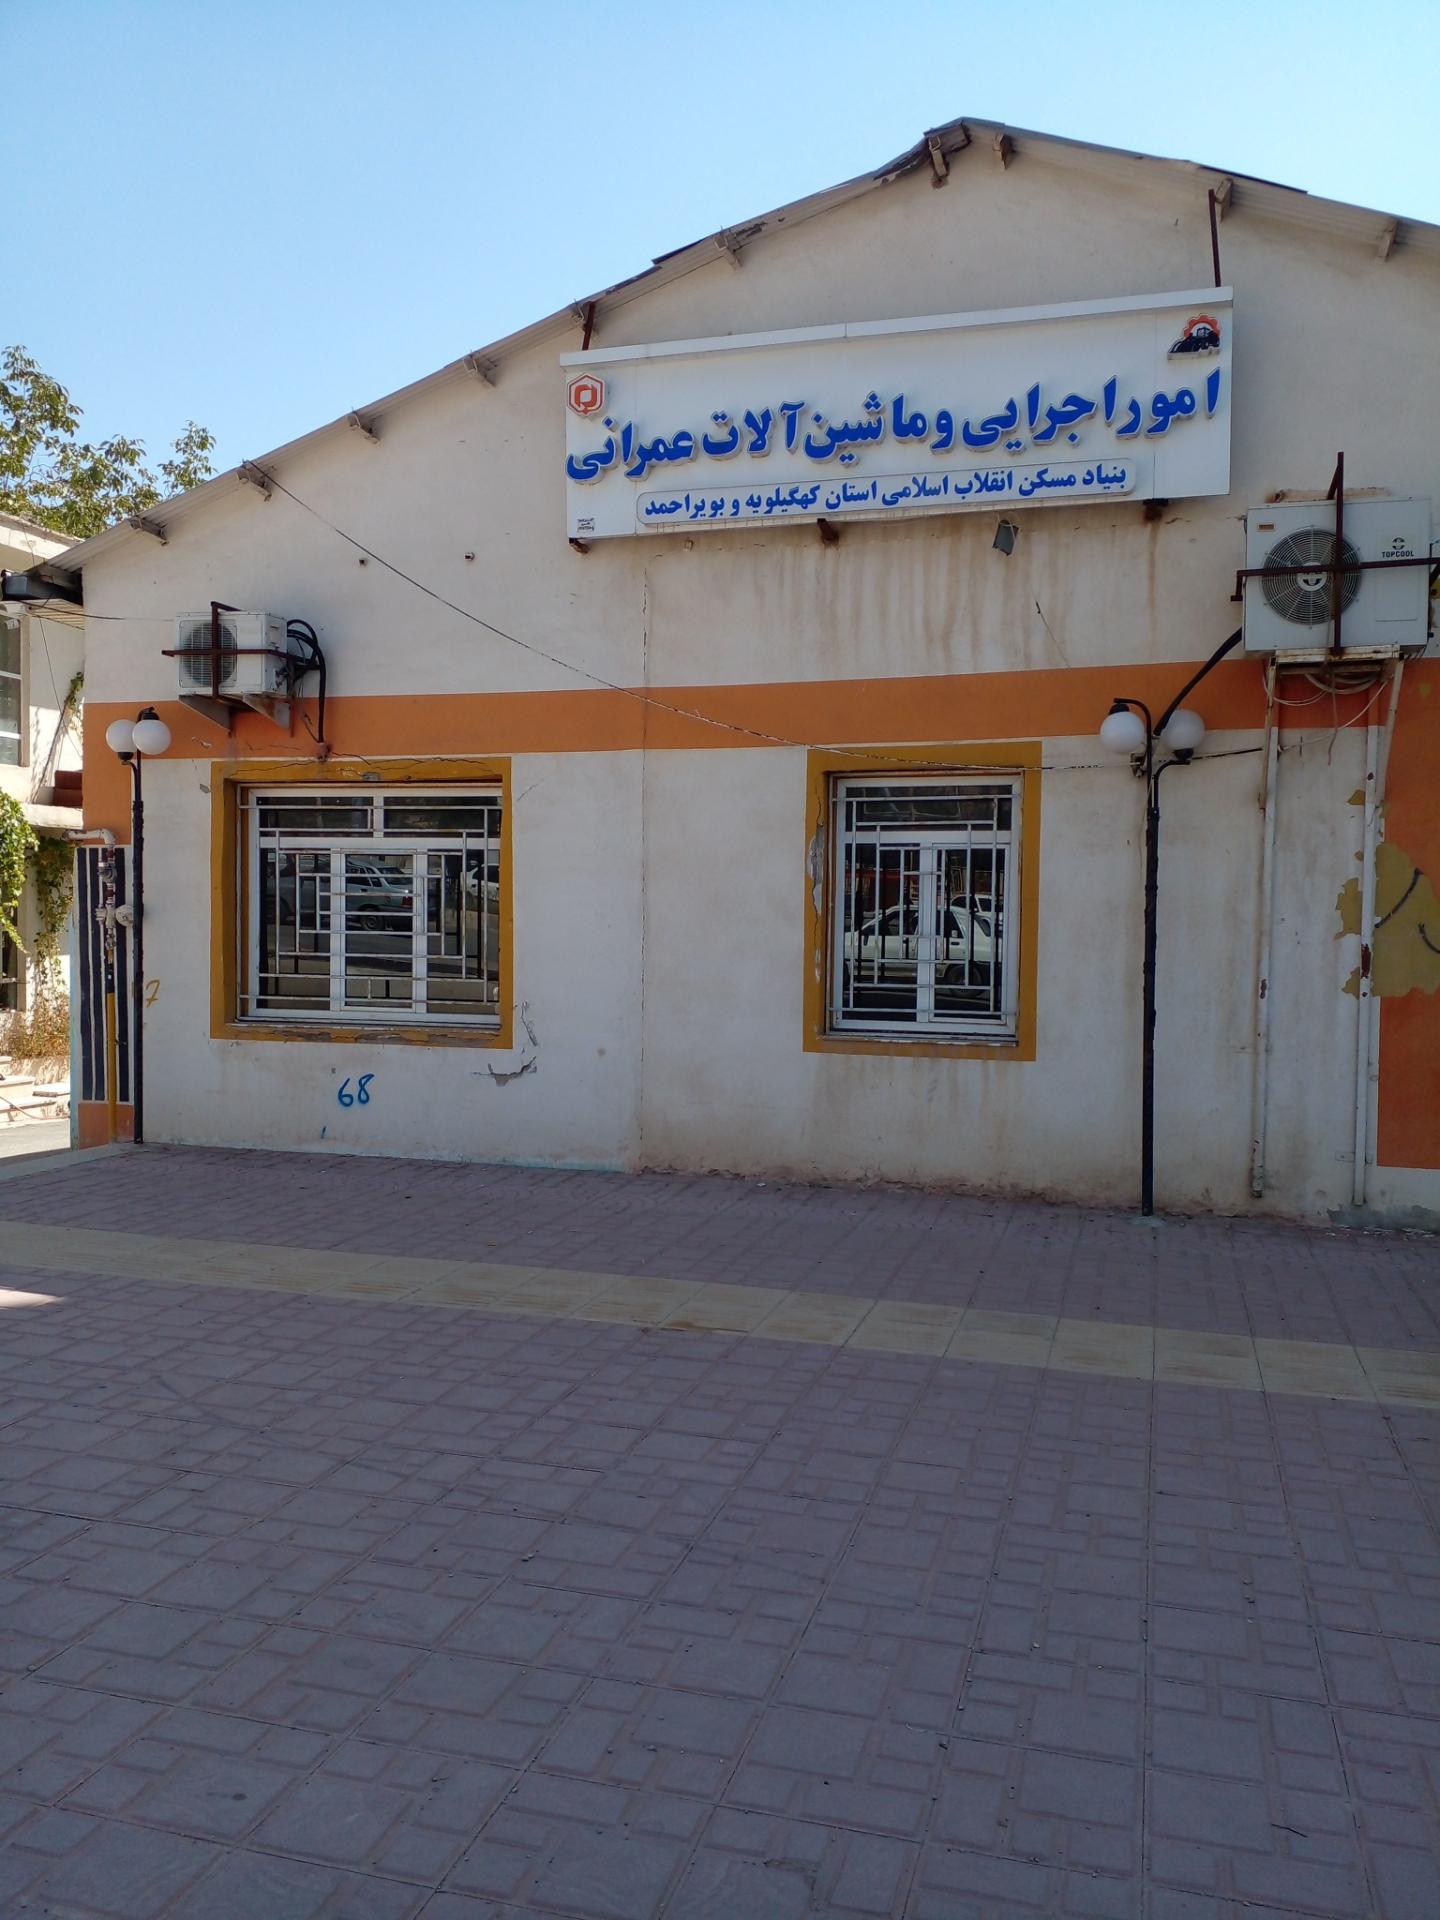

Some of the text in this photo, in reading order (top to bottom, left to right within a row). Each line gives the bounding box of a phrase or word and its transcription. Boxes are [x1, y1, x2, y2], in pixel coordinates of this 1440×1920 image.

[566, 368, 1222, 481] امور اجرایی و ماشین آلات عمرانی
[644, 464, 1127, 519] بنیاد مسکن انقلاب اسلامی استان کهگیلویه و بویراحمد
[1381, 550, 1415, 559] TOPCOOL
[337, 1073, 375, 1107] 68
